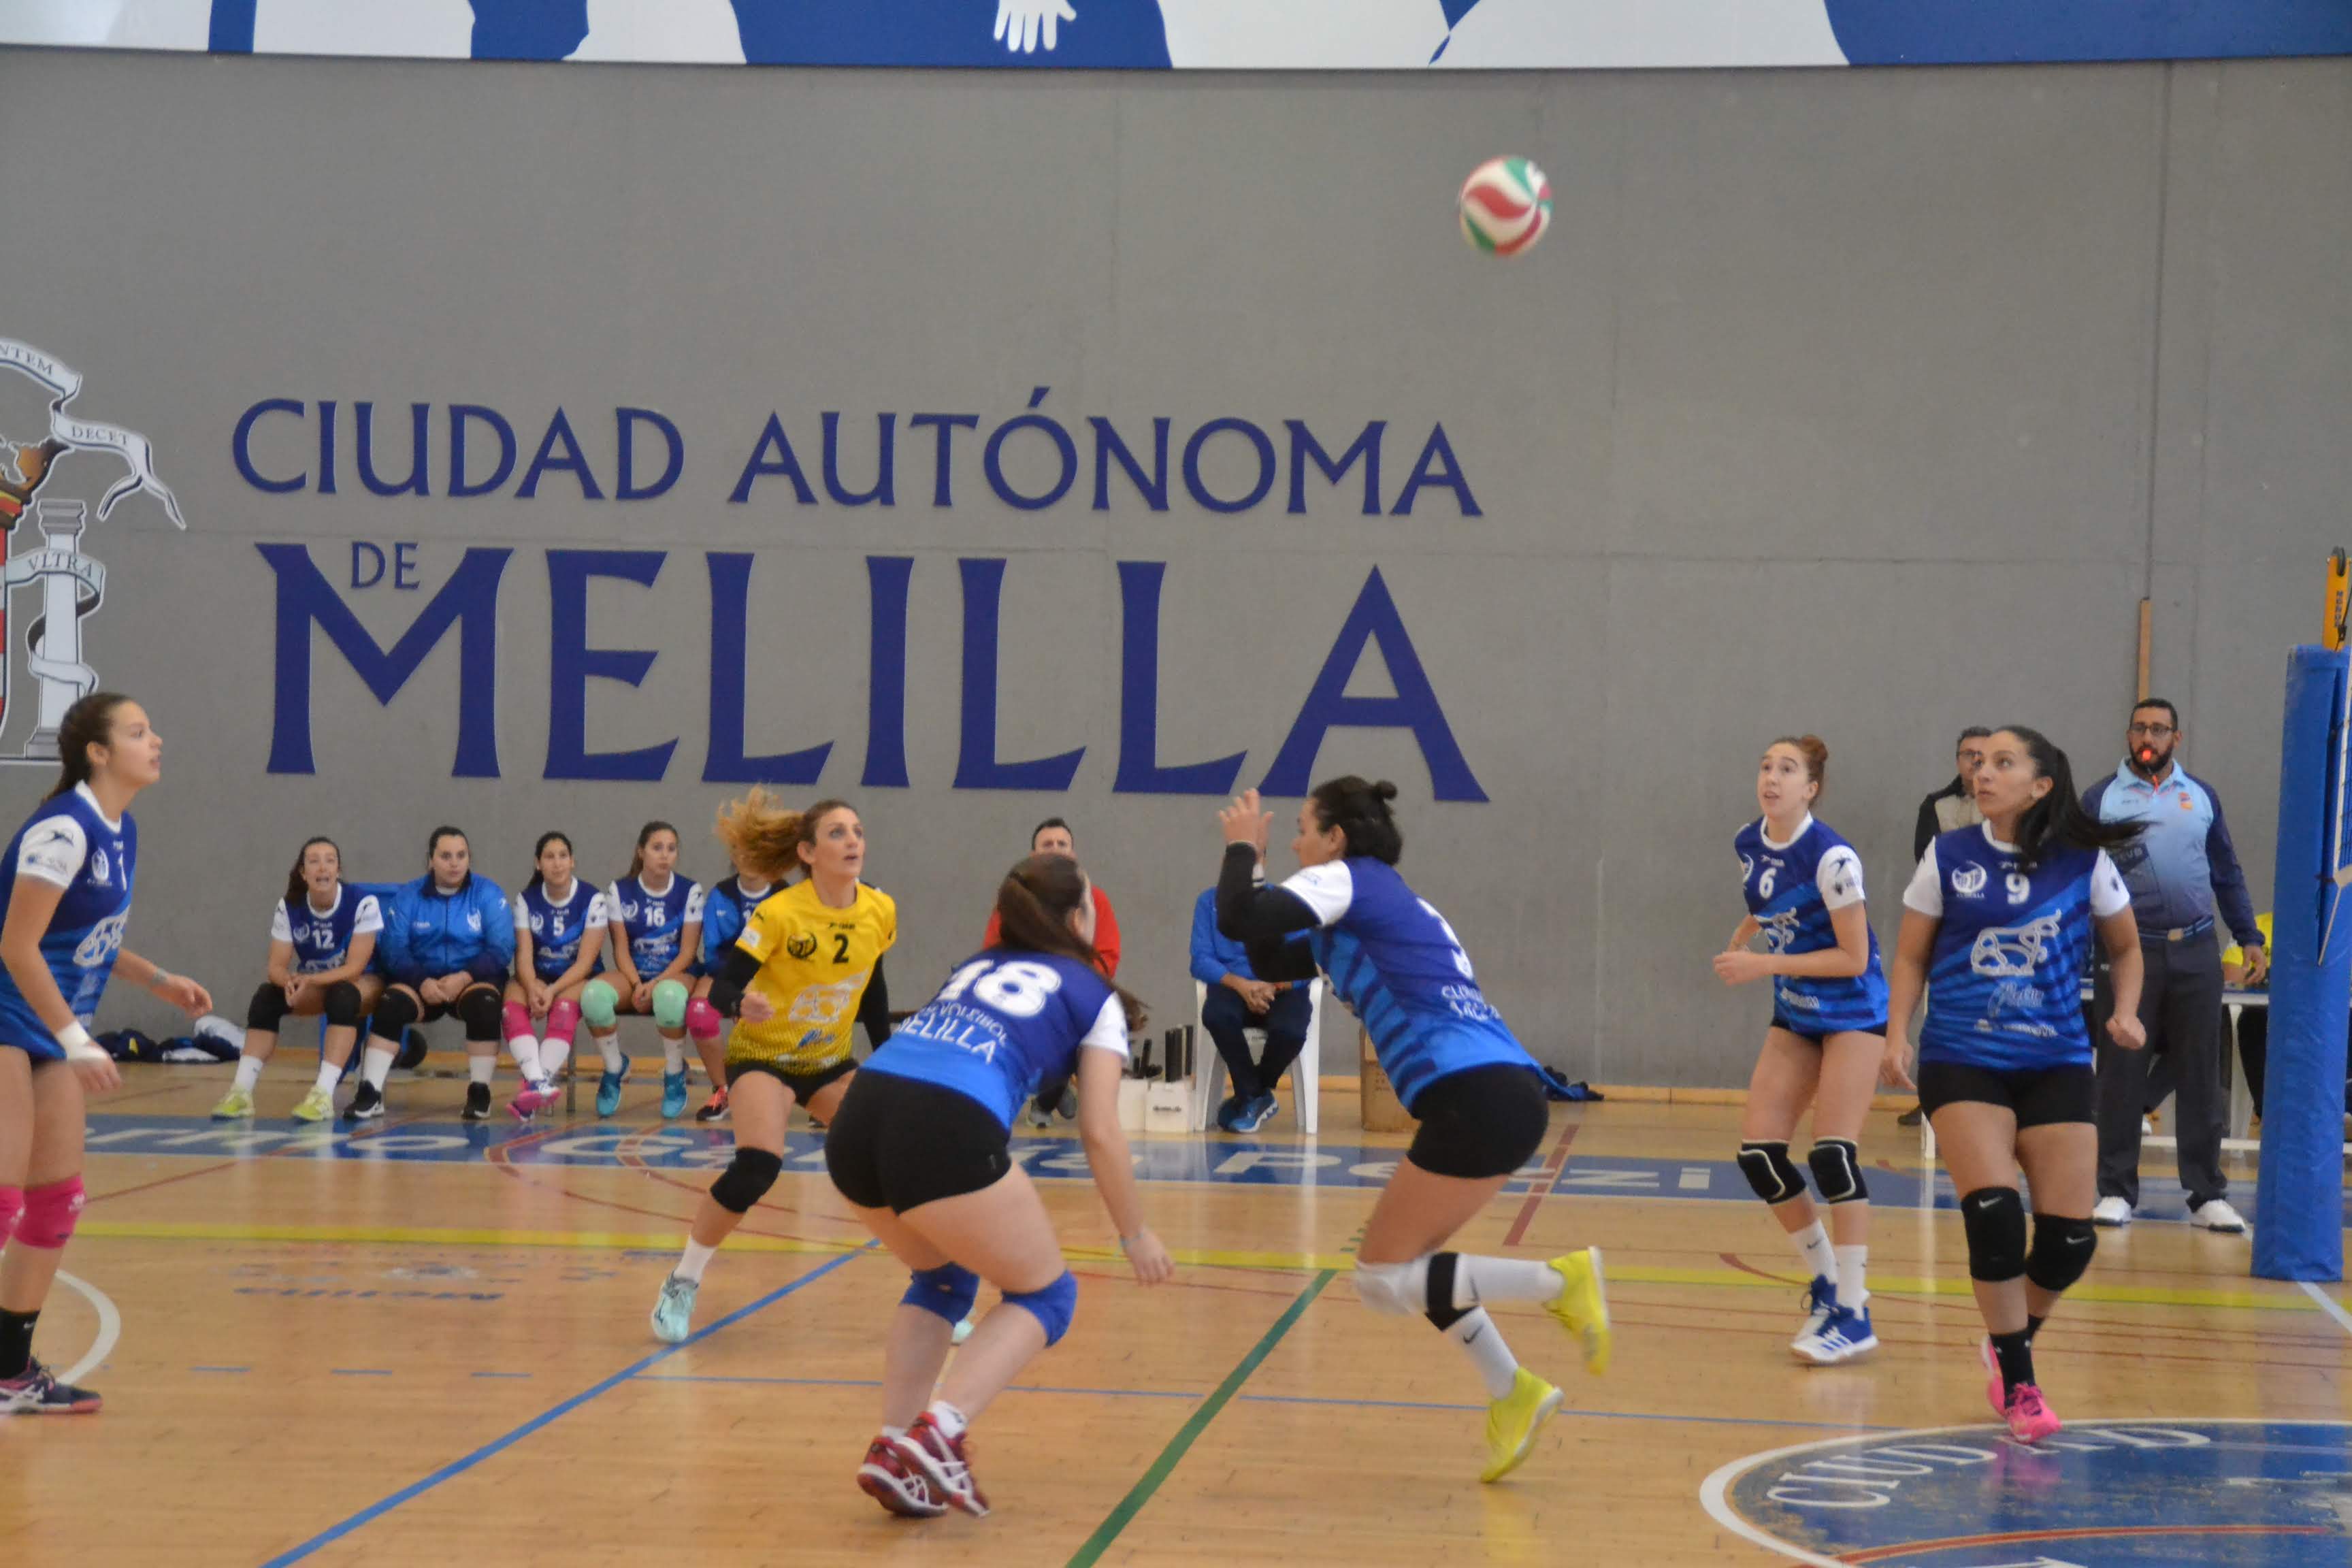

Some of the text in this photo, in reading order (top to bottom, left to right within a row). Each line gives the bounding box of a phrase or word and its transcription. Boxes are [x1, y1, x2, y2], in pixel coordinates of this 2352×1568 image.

[71, 425, 130, 446] DECET
[232, 386, 1484, 517] CIUDAD AUTÓNOMA
[29, 550, 93, 578] VLTRA
[350, 541, 421, 590] DE
[254, 541, 1490, 803] MELILLA
[1759, 867, 1777, 900] 6
[2005, 872, 2030, 905] 9
[553, 917, 566, 937] 5
[644, 907, 666, 927] 16
[312, 929, 335, 949] 12
[832, 933, 850, 964] 2
[936, 958, 1062, 1017] 18
[1767, 1427, 2211, 1509] CIUDAD
